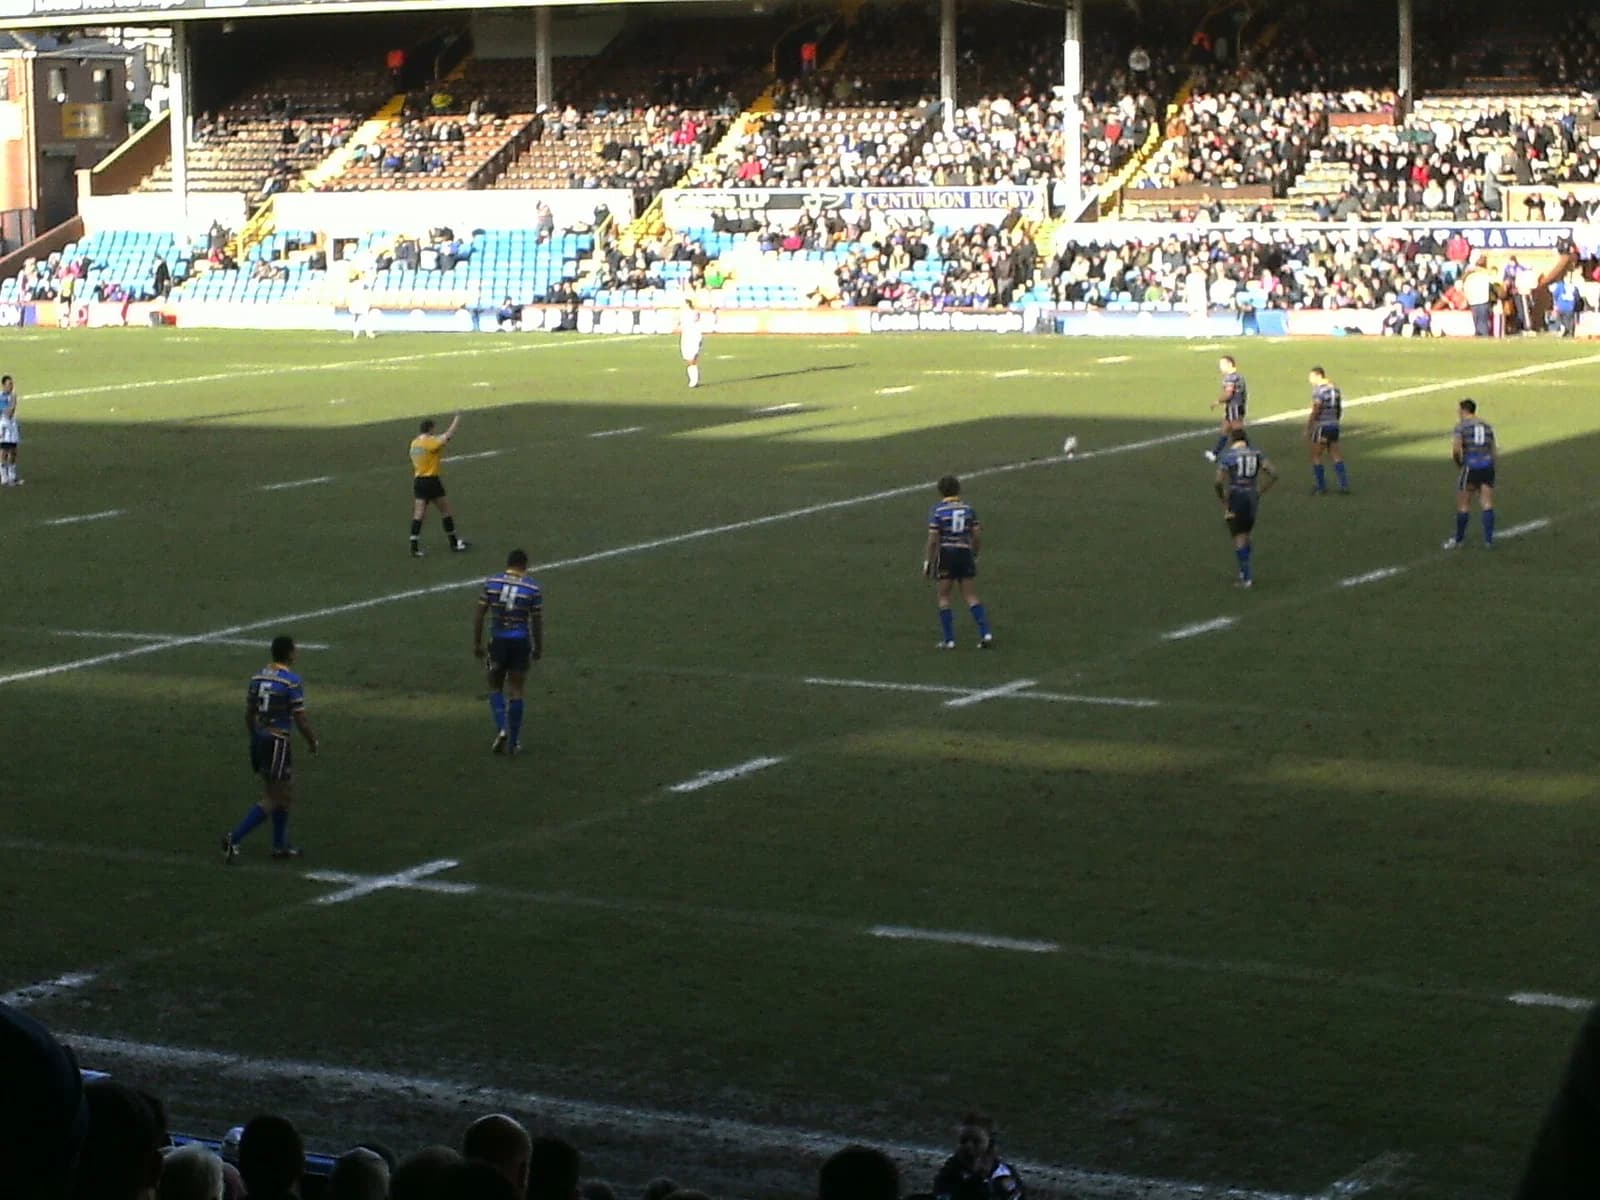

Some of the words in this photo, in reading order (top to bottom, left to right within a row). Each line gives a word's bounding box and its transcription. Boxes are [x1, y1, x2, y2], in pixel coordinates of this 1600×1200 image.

[865, 192, 965, 209] CENTURION
[969, 191, 1035, 209] RUGBY
[498, 583, 522, 610] 4
[258, 681, 273, 713] 5
